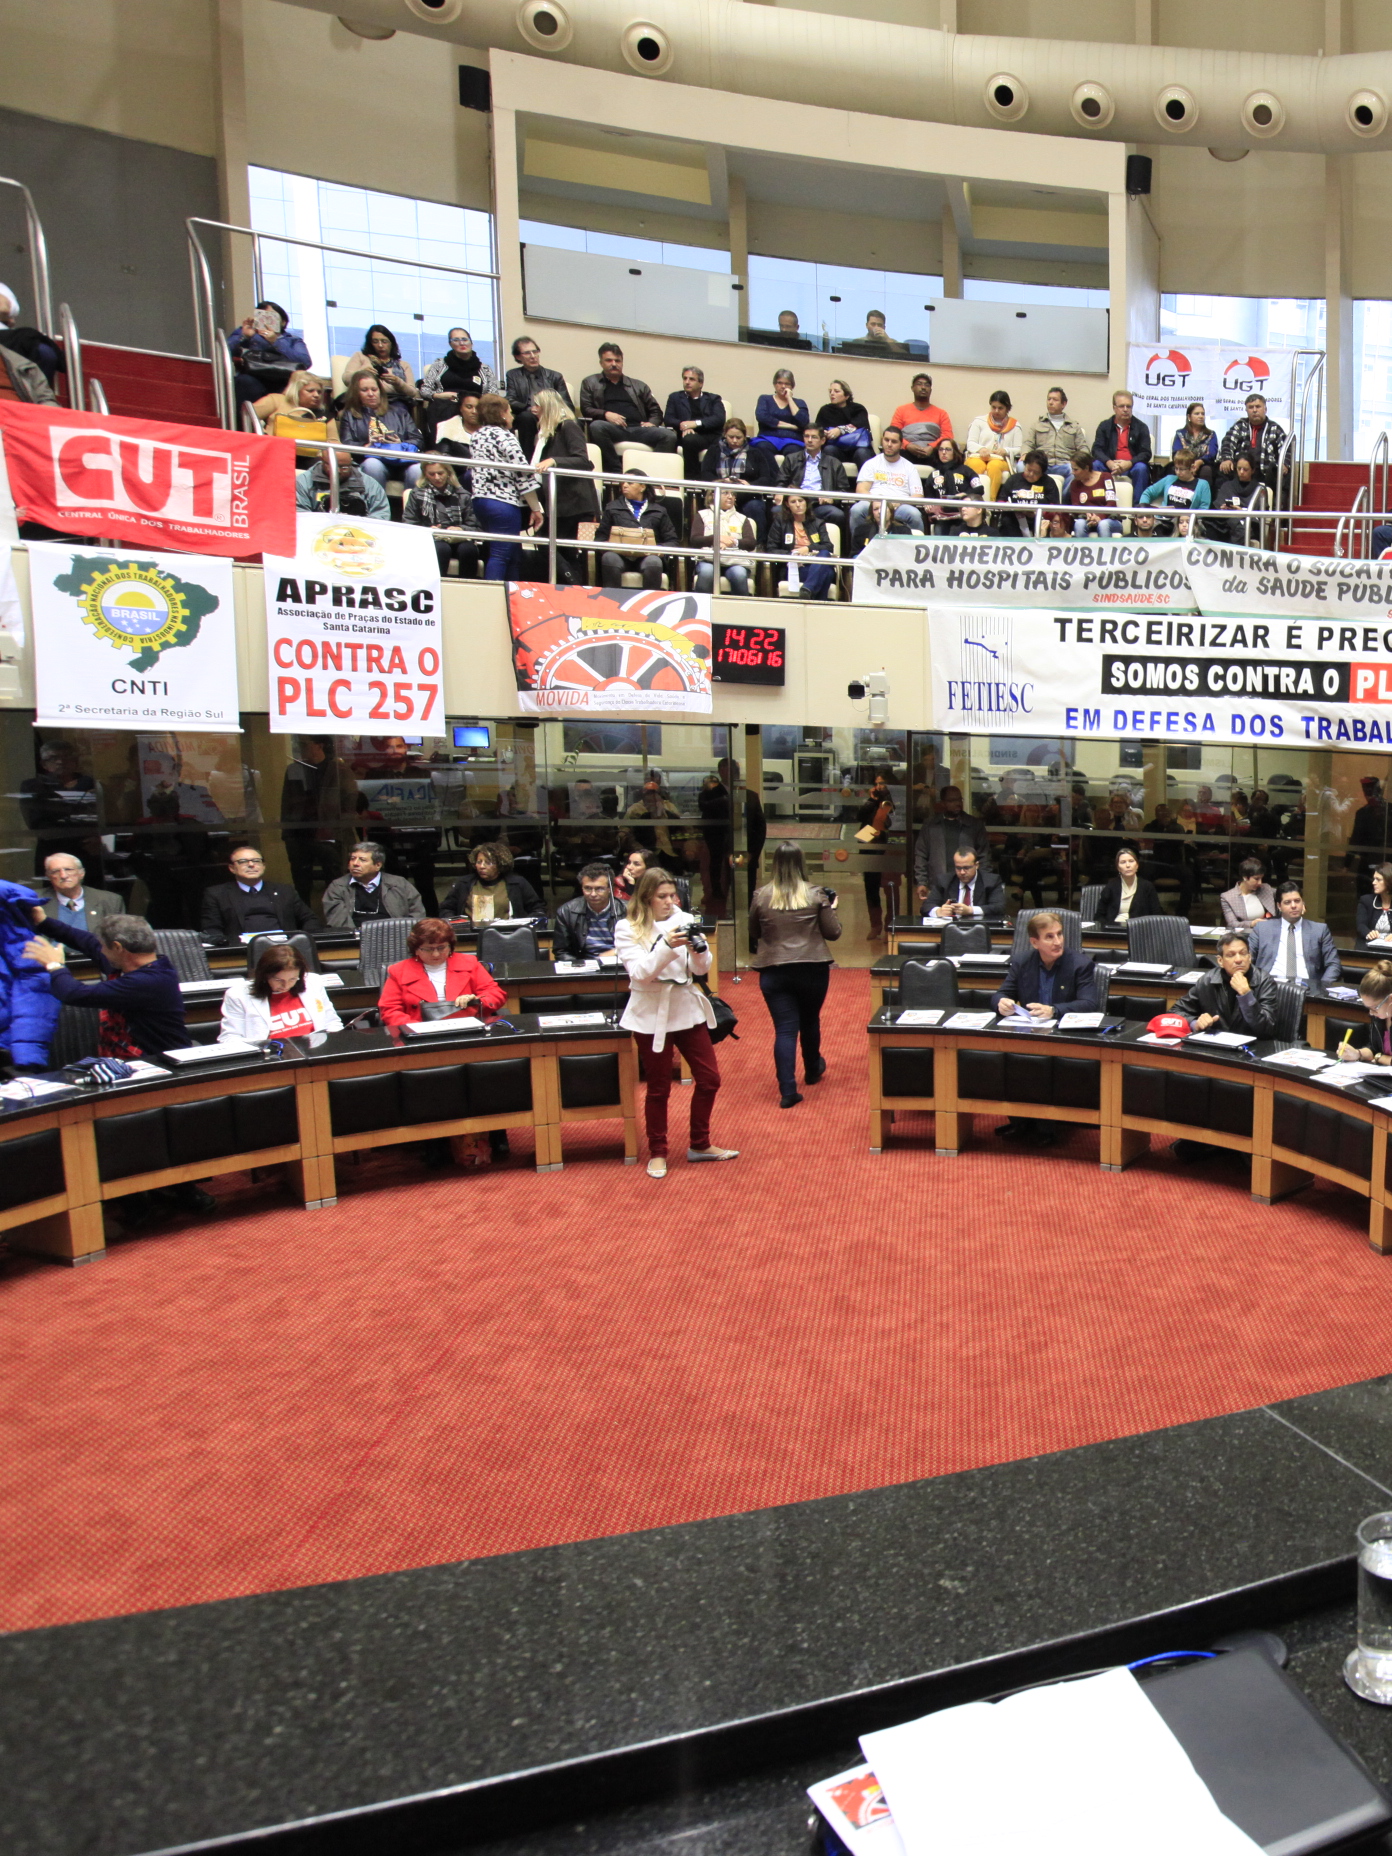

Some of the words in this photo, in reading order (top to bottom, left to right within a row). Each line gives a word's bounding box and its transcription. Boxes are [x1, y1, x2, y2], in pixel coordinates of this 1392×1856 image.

[1145, 372, 1190, 388] UGT
[1223, 378, 1268, 392] UGT
[57, 433, 226, 518] CUT
[232, 454, 249, 528] BRASIL
[58, 510, 103, 520] CENTRAL
[108, 510, 137, 523] ÚNICA
[140, 518, 163, 528] DOS
[168, 524, 250, 539] TRABALHADORES
[914, 544, 1034, 565] DINHEIRO
[1047, 543, 1149, 566] PÚBLICO
[1186, 546, 1278, 575] CONTRA
[1286, 557, 1301, 575] O
[875, 568, 935, 589] PARA
[947, 569, 1073, 591] HOSPITAIS
[1222, 576, 1248, 594] da
[1257, 576, 1328, 599] SAÚDE
[276, 576, 434, 614] APRASC
[1093, 592, 1170, 605] SINDSAÚDE/SC
[111, 609, 160, 621] BRASIL
[277, 607, 332, 620] Associação
[334, 611, 345, 620] de
[347, 612, 379, 624] Praças
[382, 614, 393, 623] do
[395, 615, 423, 625] Estado
[425, 617, 436, 626] de
[323, 621, 349, 632] Santa
[352, 624, 391, 635] Catarina
[1053, 617, 1270, 649] TERCEIRIZAR
[1286, 619, 1302, 649] É
[274, 637, 408, 675] CONTRA
[418, 647, 440, 677] O
[111, 678, 169, 696] CNTI
[1110, 661, 1199, 691] SOMOS
[1207, 664, 1315, 695] CONTRA
[1323, 669, 1340, 695] O
[277, 676, 352, 718] PLC
[368, 680, 439, 721] 257
[536, 690, 589, 706] MOVIDA
[947, 681, 1034, 713] FETIESC
[74, 704, 138, 716] Secretaria
[143, 707, 157, 717] da
[160, 708, 201, 720] Região
[205, 708, 224, 719] Sul
[1066, 708, 1101, 730] EM
[1113, 709, 1215, 735] DEFESA
[1231, 713, 1284, 739] DOS
